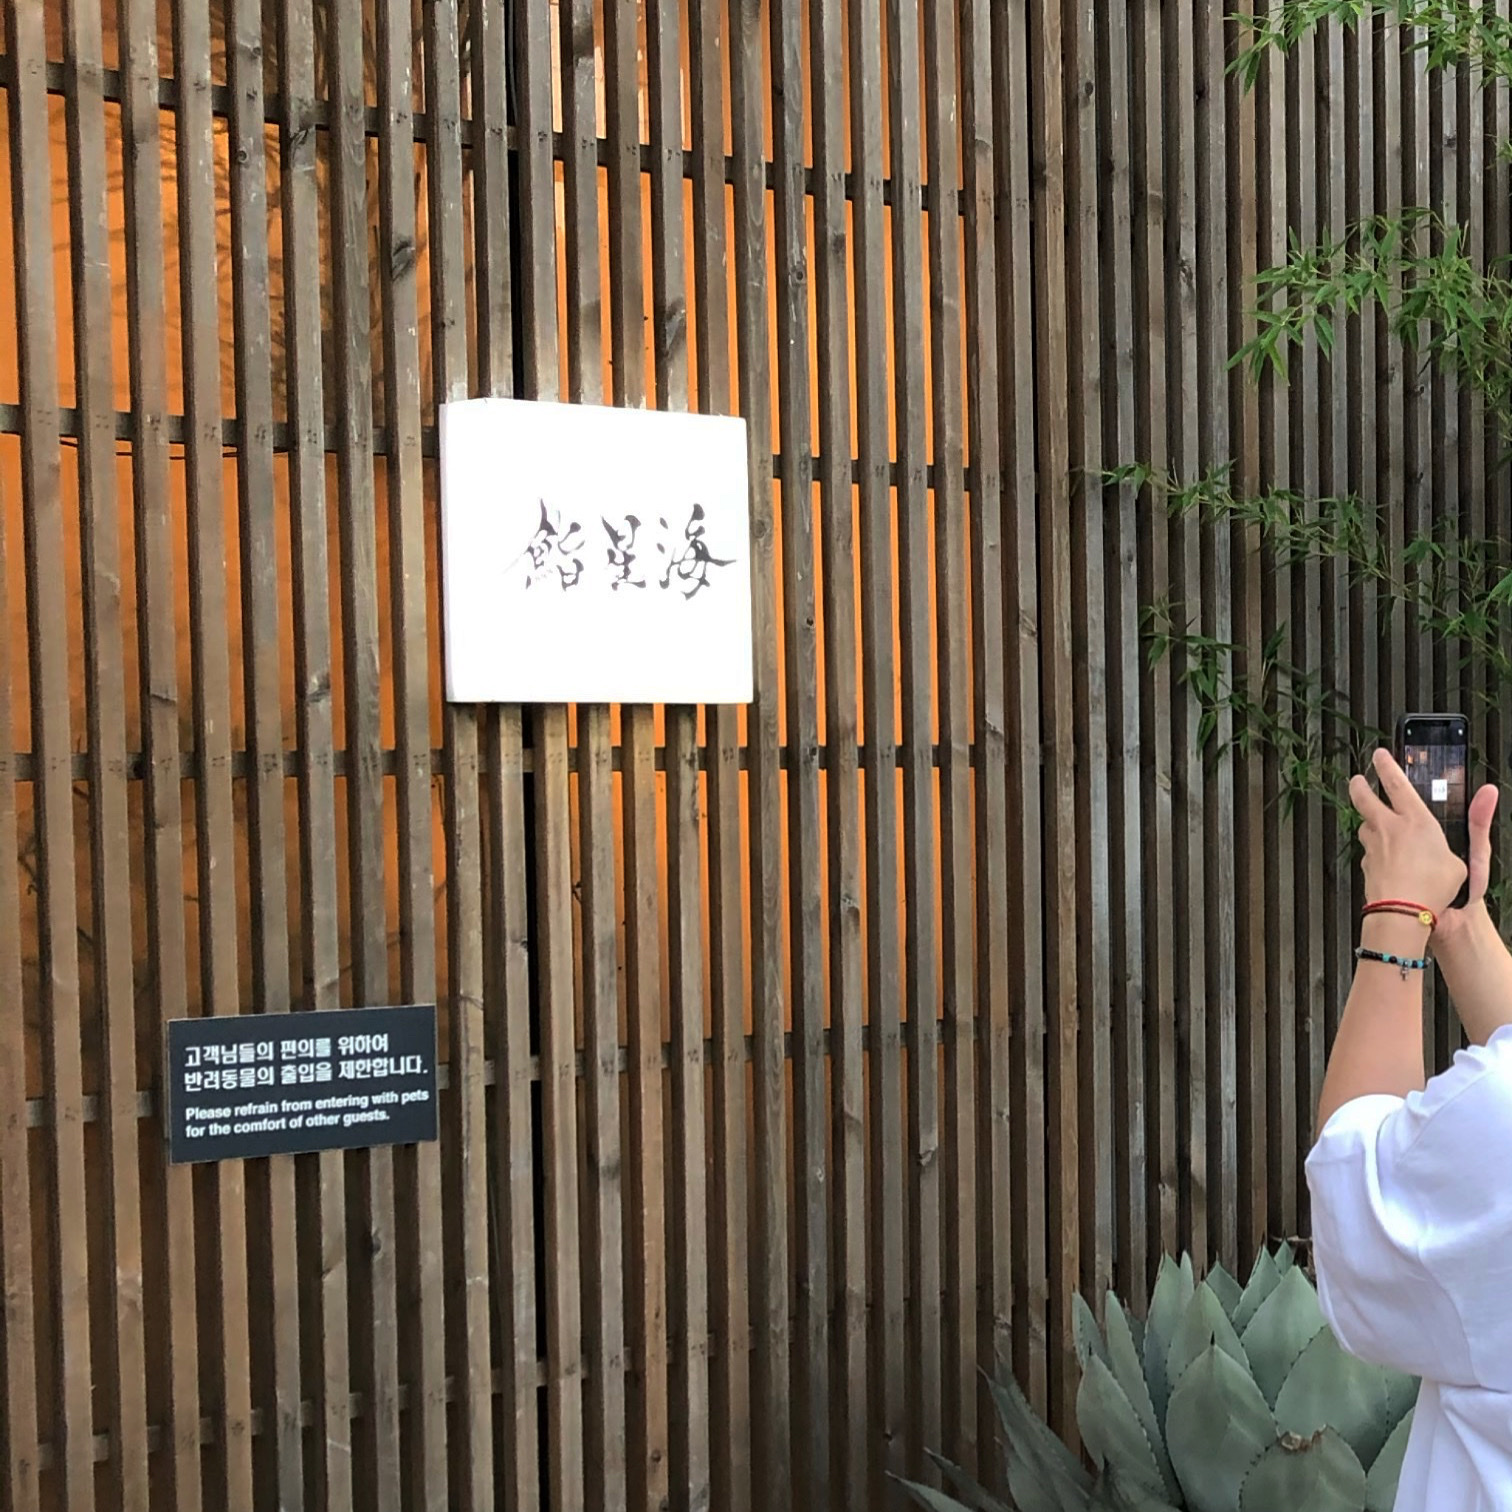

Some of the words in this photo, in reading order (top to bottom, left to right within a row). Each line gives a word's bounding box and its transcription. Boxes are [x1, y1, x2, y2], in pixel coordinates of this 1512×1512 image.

[184, 1041, 274, 1067] 고객님들의
[280, 1038, 332, 1060] 편의를
[337, 1033, 389, 1056] 위하여
[184, 1066, 275, 1092] 반려동물의
[281, 1061, 332, 1085] 출입을
[338, 1055, 428, 1080] 제한합니다.
[185, 1107, 232, 1121] Please
[234, 1101, 278, 1117] refrain
[281, 1099, 313, 1113] from
[315, 1094, 369, 1109] entering
[371, 1091, 399, 1105] with
[401, 1089, 430, 1105] pets
[185, 1124, 206, 1138] for
[208, 1122, 232, 1136] the
[233, 1117, 287, 1134] comfort
[289, 1114, 304, 1129] of
[305, 1113, 341, 1128] other
[342, 1109, 390, 1128] guests.
